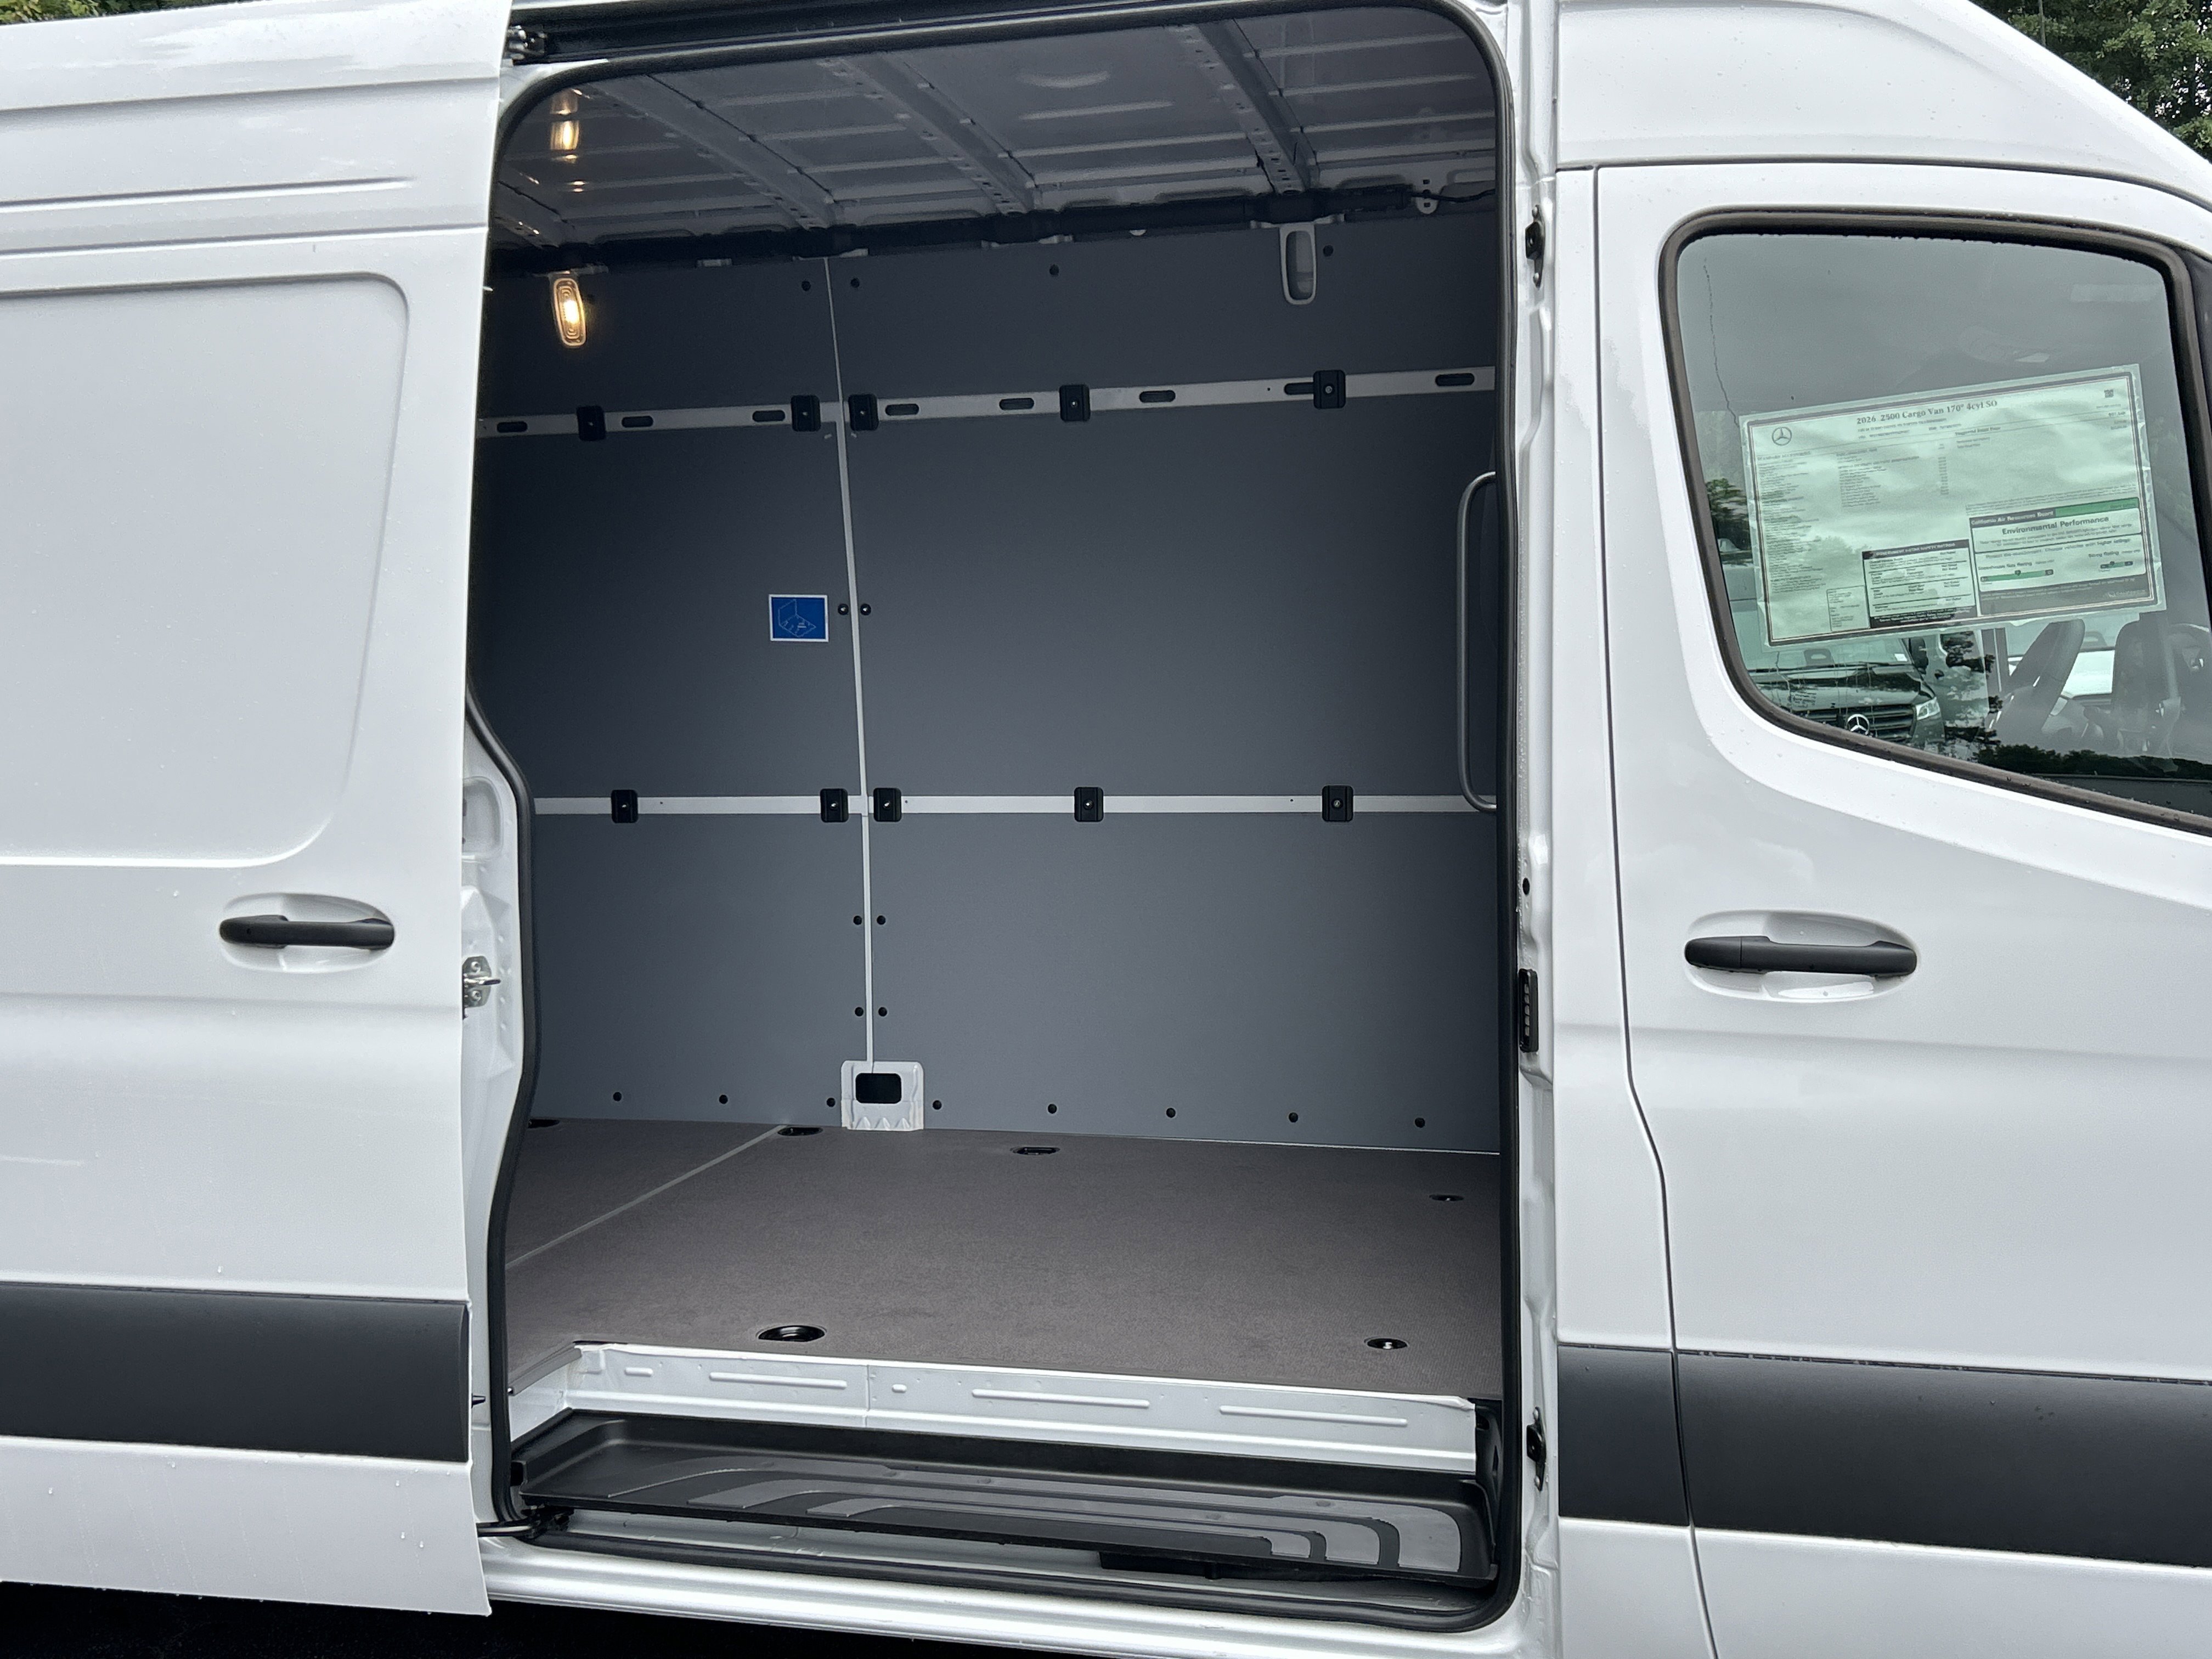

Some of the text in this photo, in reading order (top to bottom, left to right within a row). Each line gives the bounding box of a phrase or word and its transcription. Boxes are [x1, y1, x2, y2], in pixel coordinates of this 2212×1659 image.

[1857, 415, 1876, 424] 2026
[1880, 413, 1900, 421] 2500
[1902, 410, 1926, 419] Cargo
[1966, 402, 1984, 410] 4cyl
[2002, 522, 2057, 535] Environmental
[2059, 517, 2109, 528] Performance
